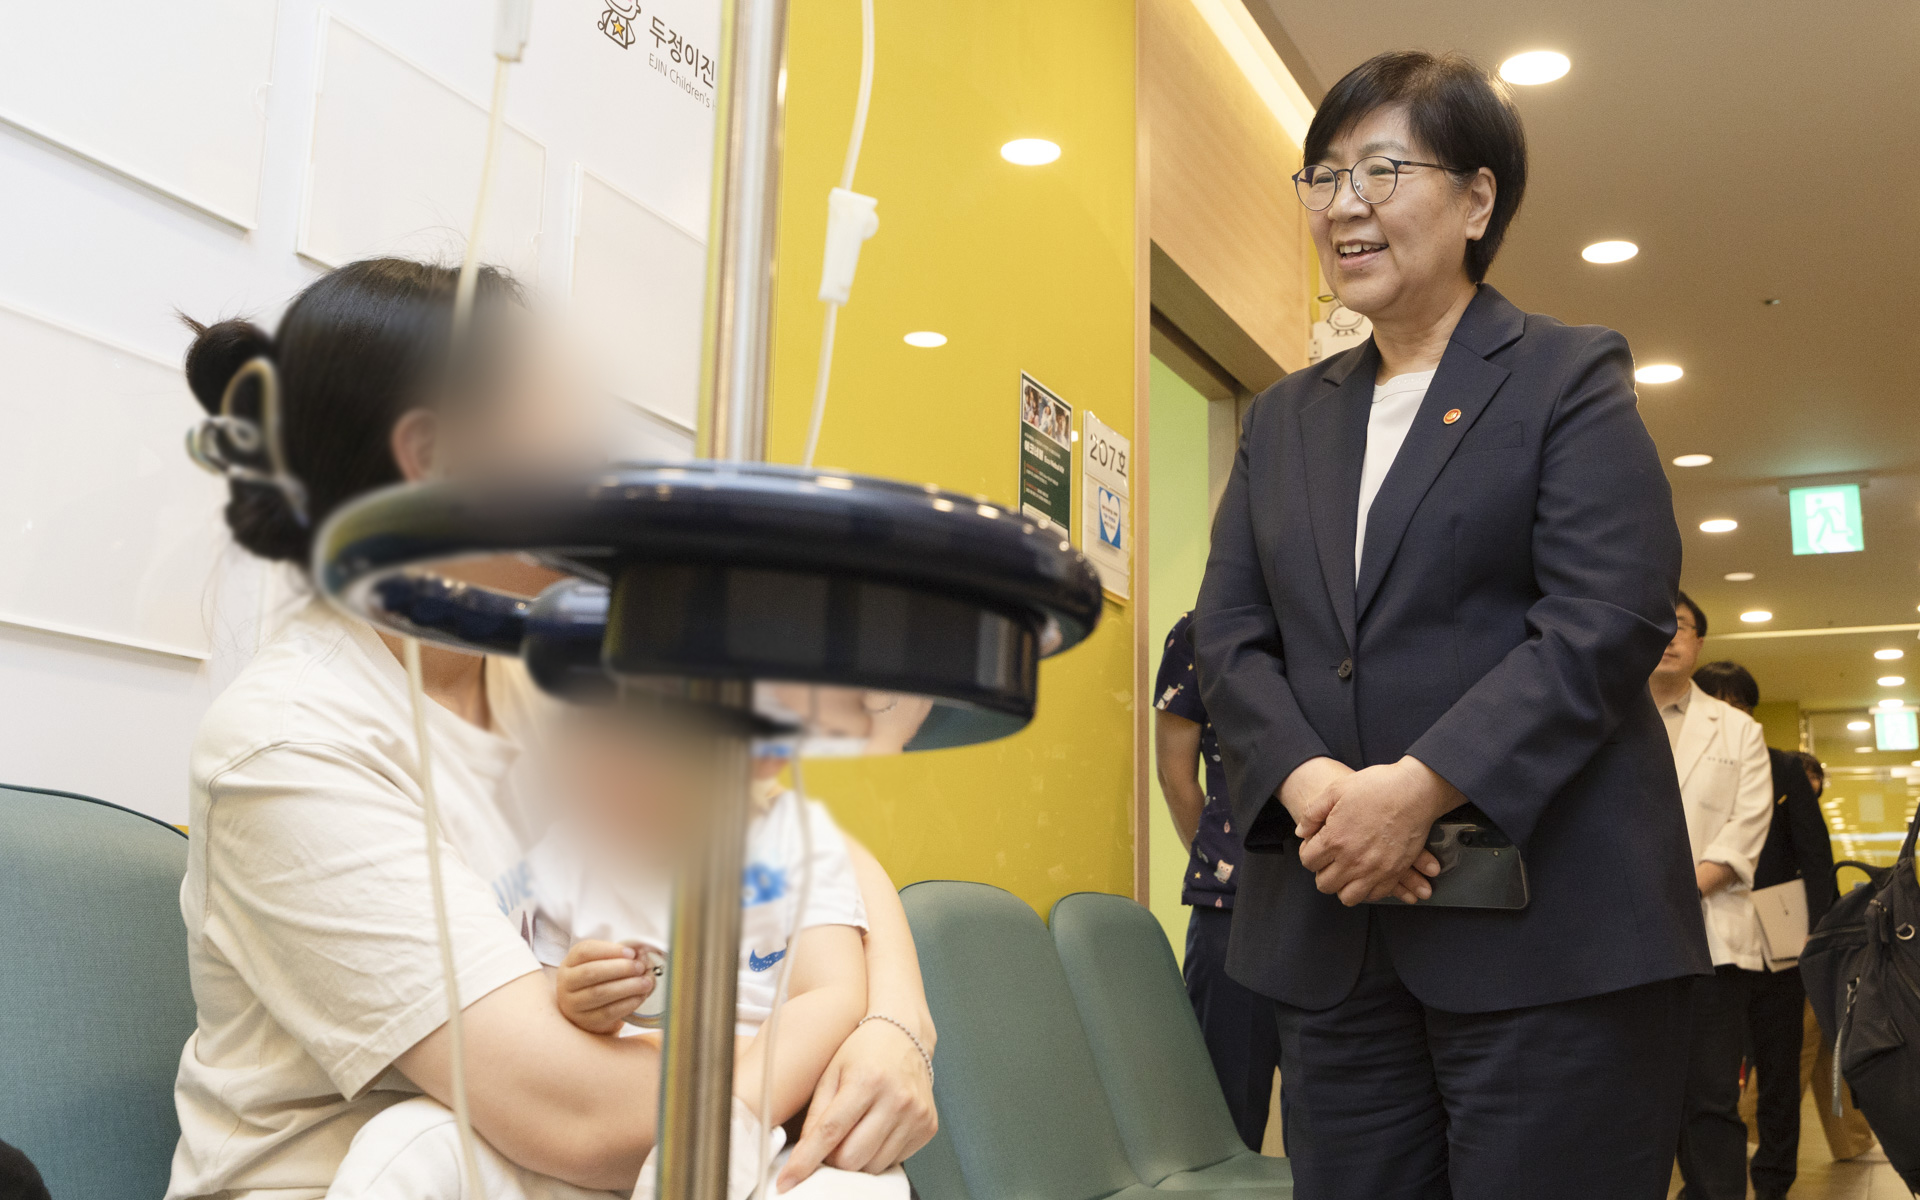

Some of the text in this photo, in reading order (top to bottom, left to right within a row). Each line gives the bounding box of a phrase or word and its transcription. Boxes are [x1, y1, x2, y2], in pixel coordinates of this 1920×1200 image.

[649, 53, 710, 108] EJIN Children's
[1090, 432, 1127, 478] 207호
